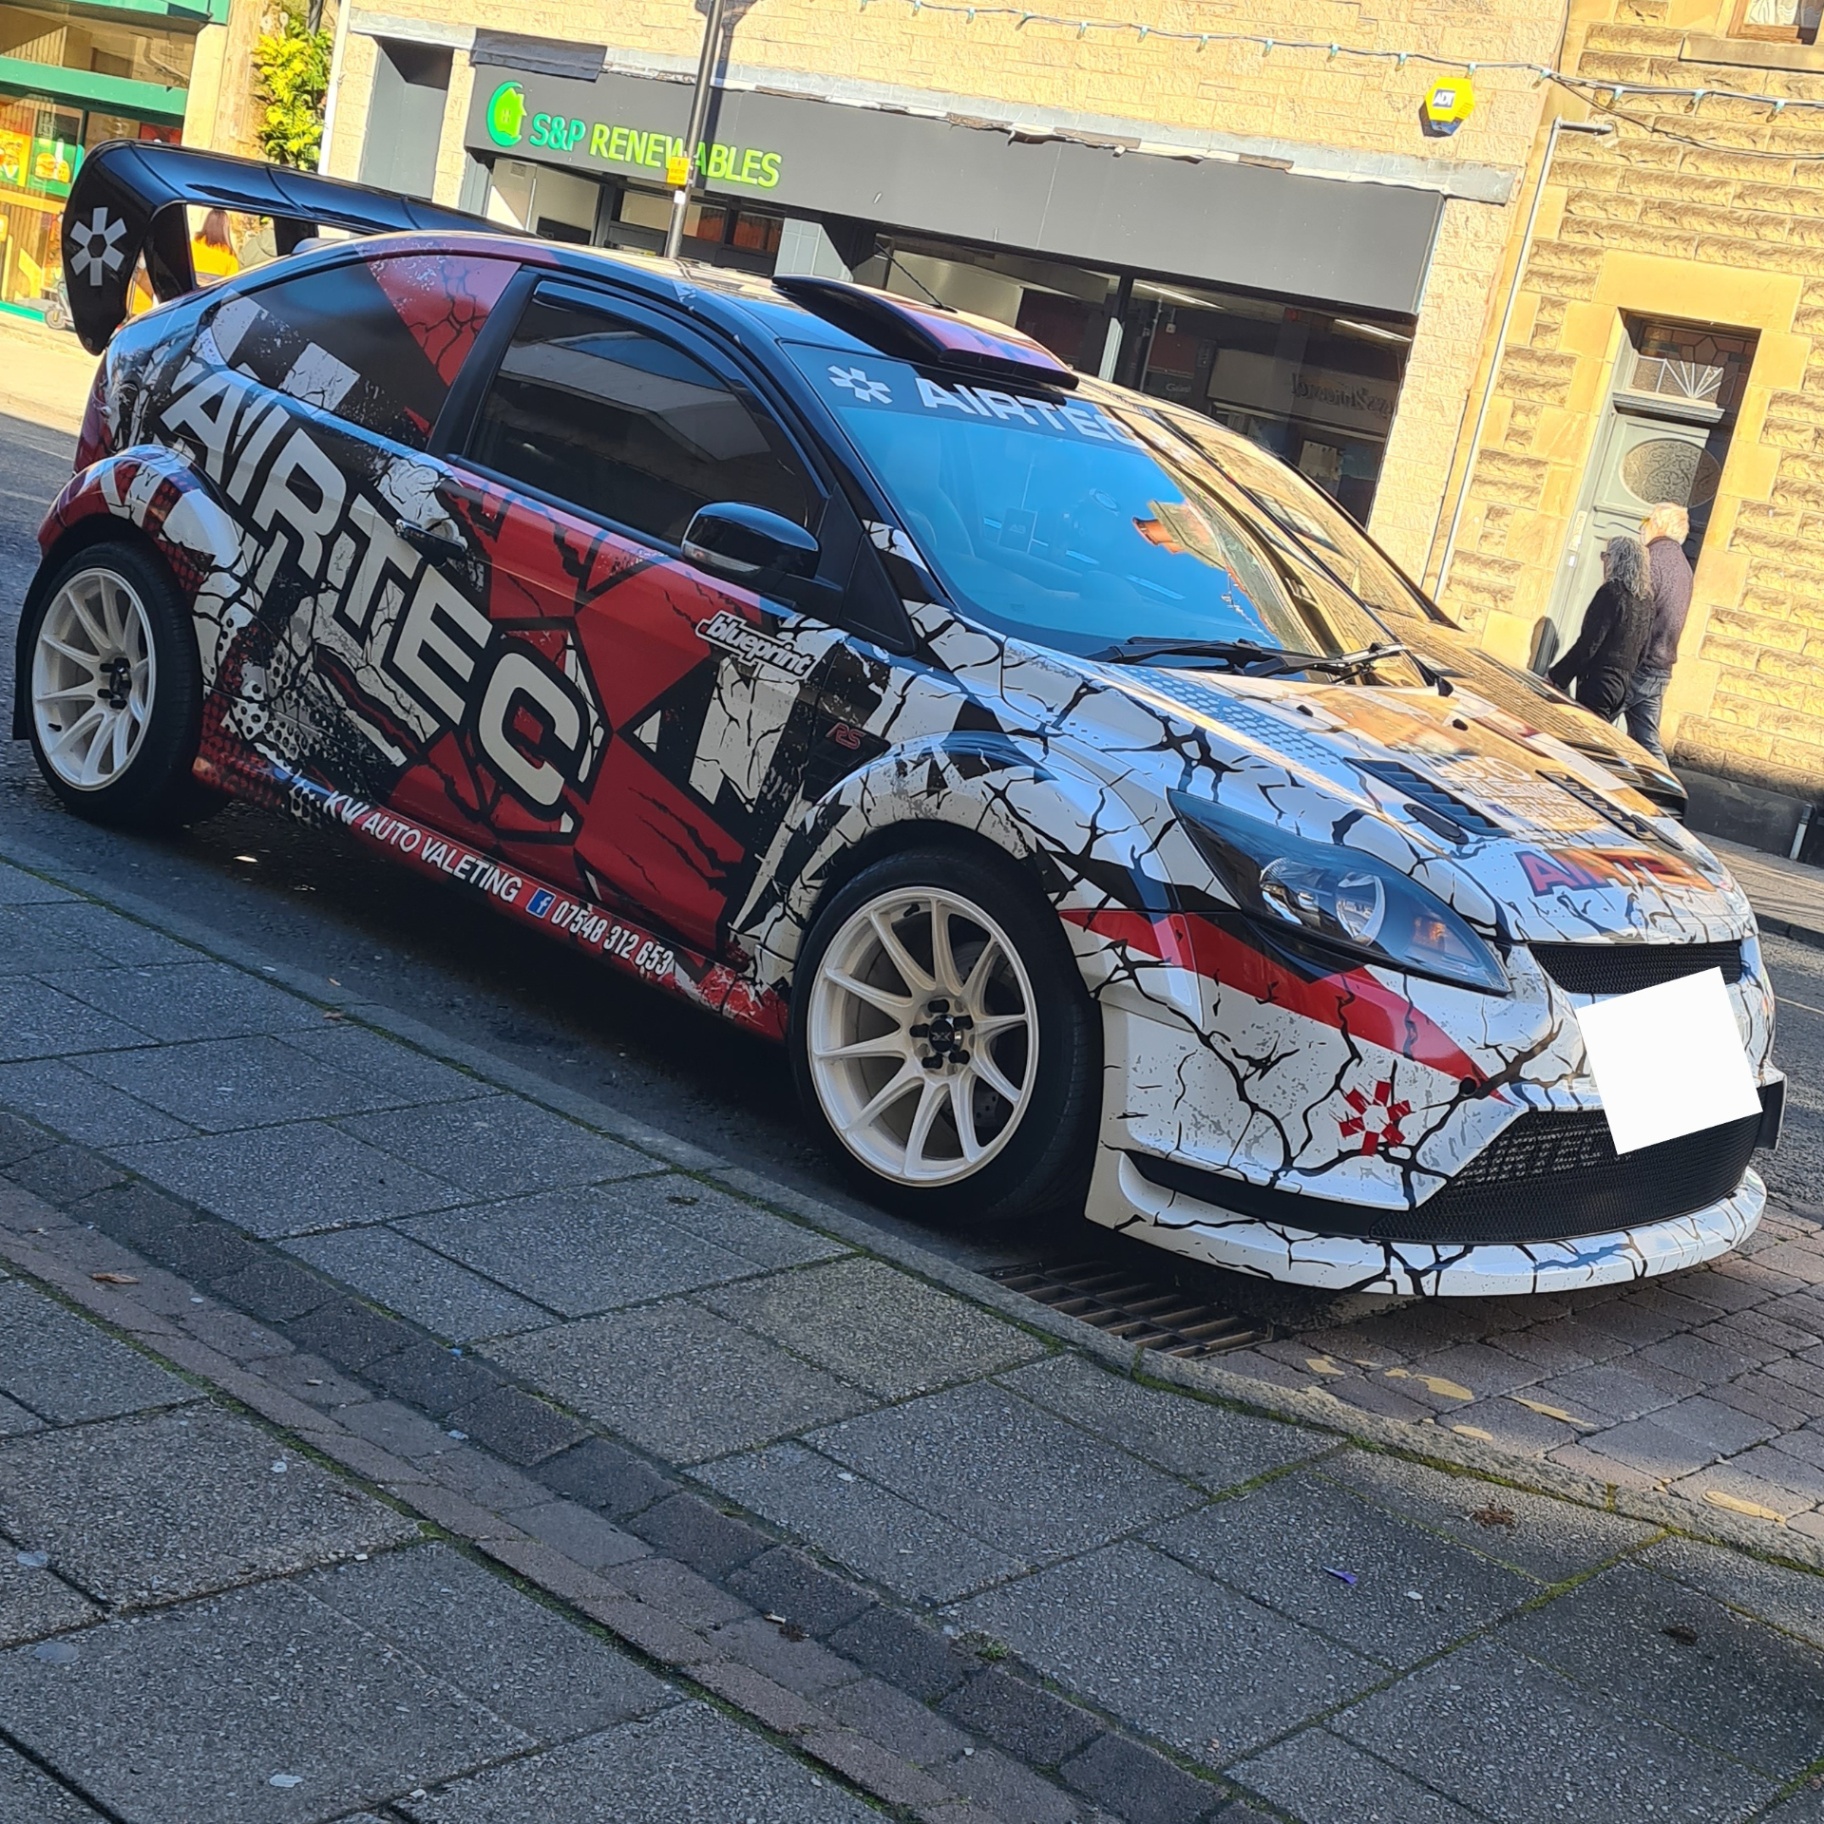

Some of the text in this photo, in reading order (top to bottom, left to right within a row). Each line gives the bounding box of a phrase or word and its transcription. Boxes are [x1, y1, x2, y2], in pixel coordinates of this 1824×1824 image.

[529, 112, 586, 151] S&P
[915, 377, 1149, 450] AIRTEC
[159, 371, 580, 806] AIRTEC
[706, 615, 815, 676] blueprint
[826, 722, 866, 749] RS
[323, 790, 370, 825] KW
[361, 811, 421, 853] AUTO
[420, 837, 522, 902] VALETING
[551, 901, 608, 943] 07548
[604, 926, 640, 960] 312
[635, 941, 674, 975] 653
